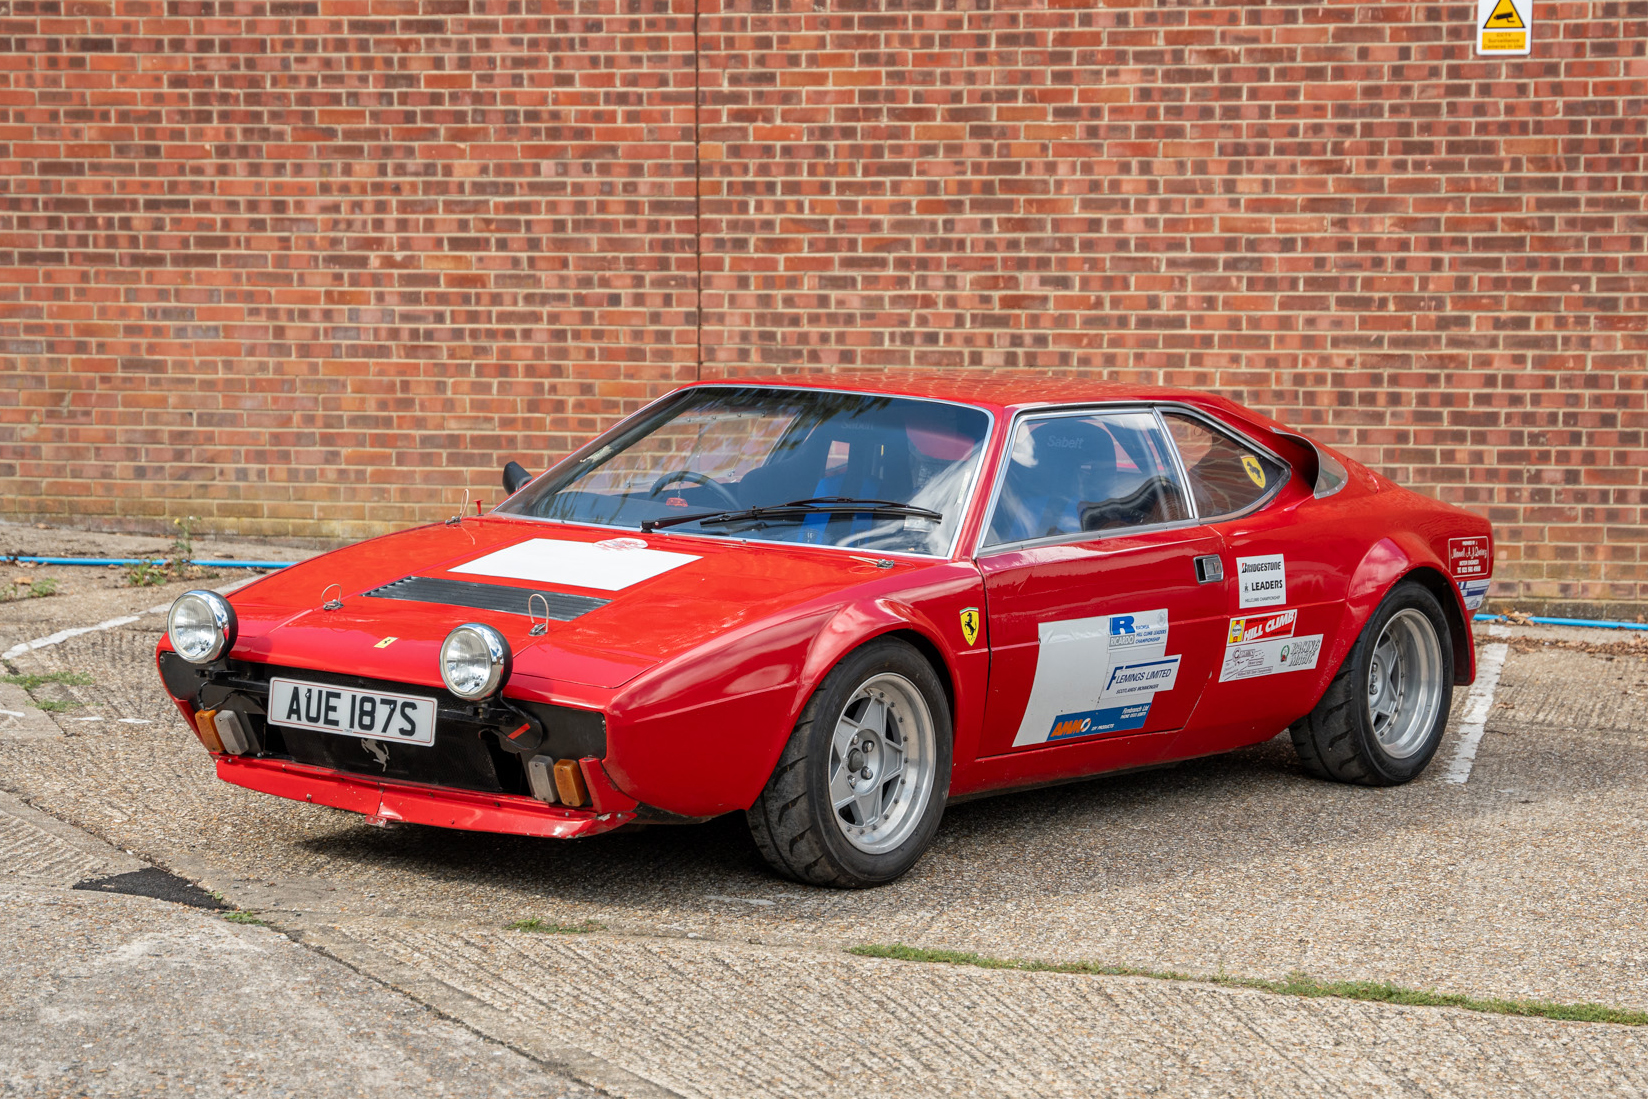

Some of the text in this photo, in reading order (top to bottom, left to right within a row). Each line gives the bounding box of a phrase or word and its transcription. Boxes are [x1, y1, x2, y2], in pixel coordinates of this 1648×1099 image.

[1047, 435, 1084, 449] Sabelt
[1241, 561, 1281, 573] BRIDGESTONE
[1251, 579, 1283, 591] LEADERS
[1243, 611, 1294, 641] HILL CLIMB
[1110, 636, 1134, 645] RICARDO
[1135, 636, 1160, 644] CHAMPIONSHIP
[1106, 666, 1172, 690] FLEMINGS LIMITED
[285, 686, 418, 738] AUE 187S
[1050, 718, 1091, 737] AMMO
